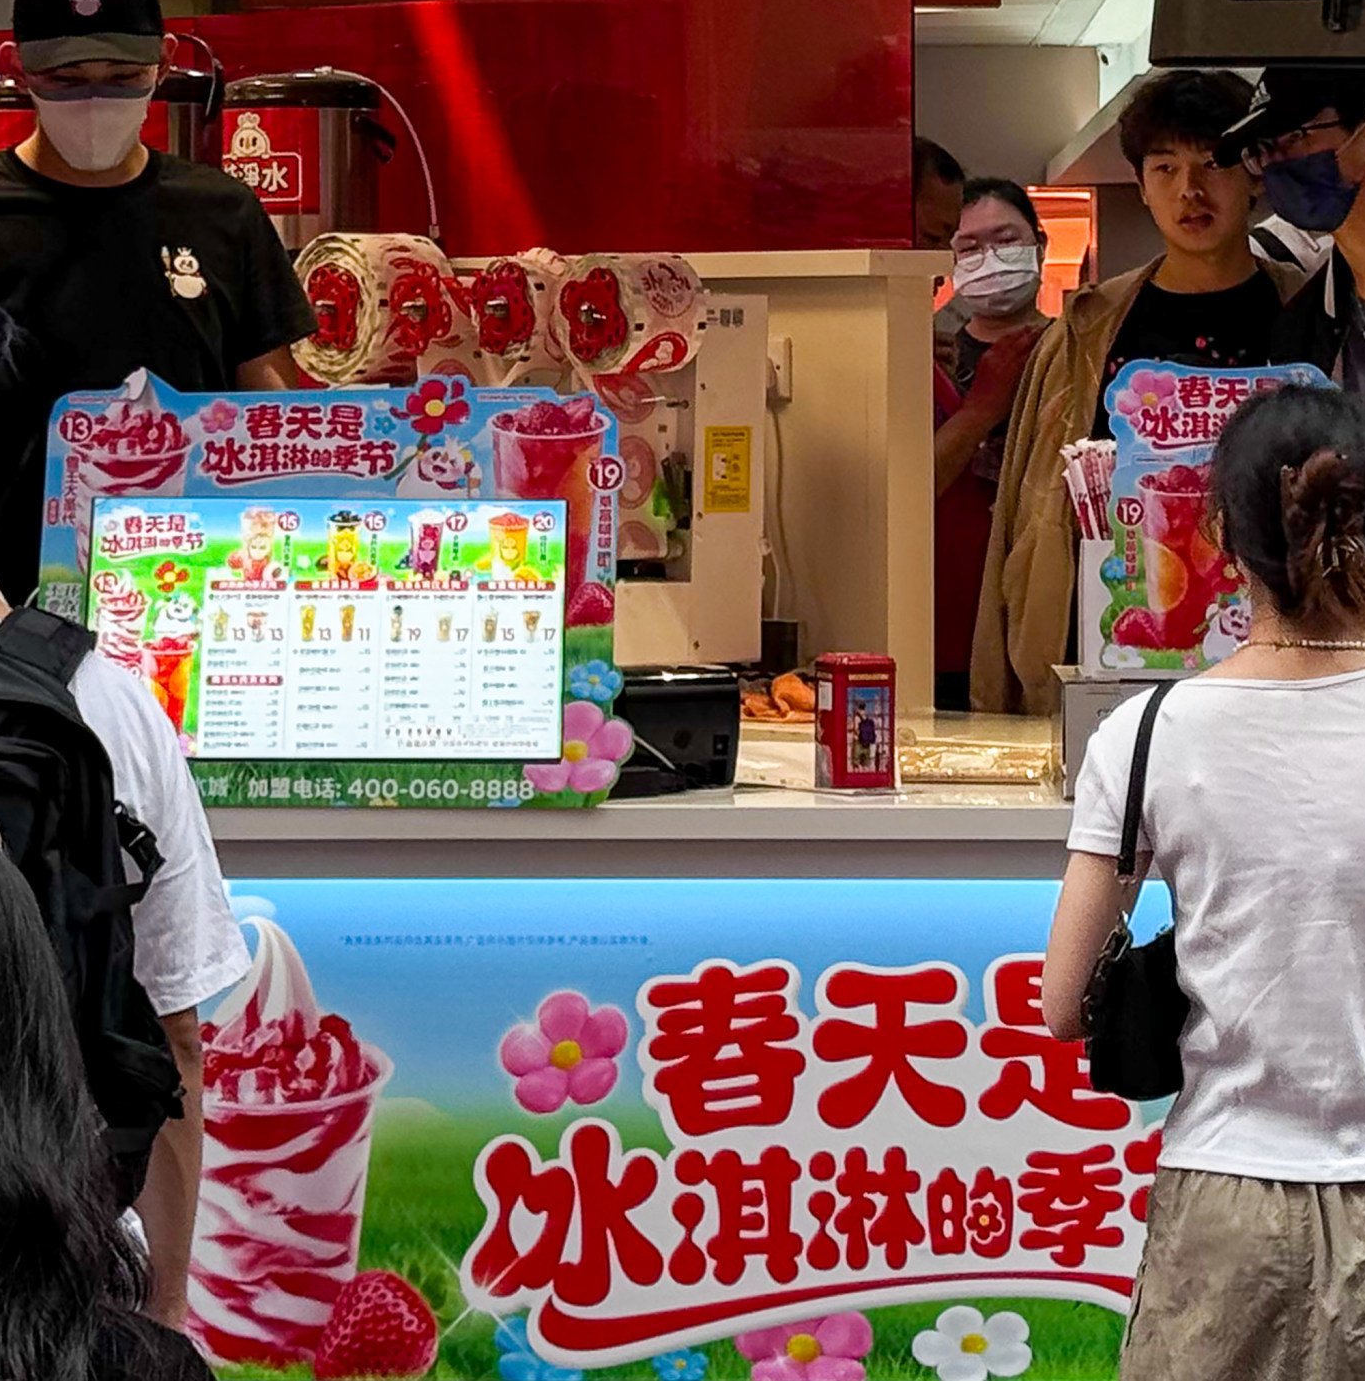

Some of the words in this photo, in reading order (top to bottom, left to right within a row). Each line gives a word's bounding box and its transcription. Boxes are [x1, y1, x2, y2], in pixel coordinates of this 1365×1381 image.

[65, 417, 89, 440] 13
[246, 404, 364, 441] 春天是
[200, 437, 396, 476] 冰淇淋的季节
[594, 463, 621, 488] 19
[1122, 502, 1142, 518] 19
[98, 576, 116, 592] 13
[232, 628, 246, 641] 13
[270, 628, 284, 641] 13
[319, 628, 332, 641] 13
[359, 628, 370, 641] 11
[408, 628, 421, 641] 19
[456, 628, 469, 641] 17
[503, 628, 515, 641] 15
[543, 628, 556, 641] 17
[247, 777, 341, 800] 加盟电话:
[347, 778, 536, 800] 400-060-8888
[647, 960, 1132, 1135] 春天是
